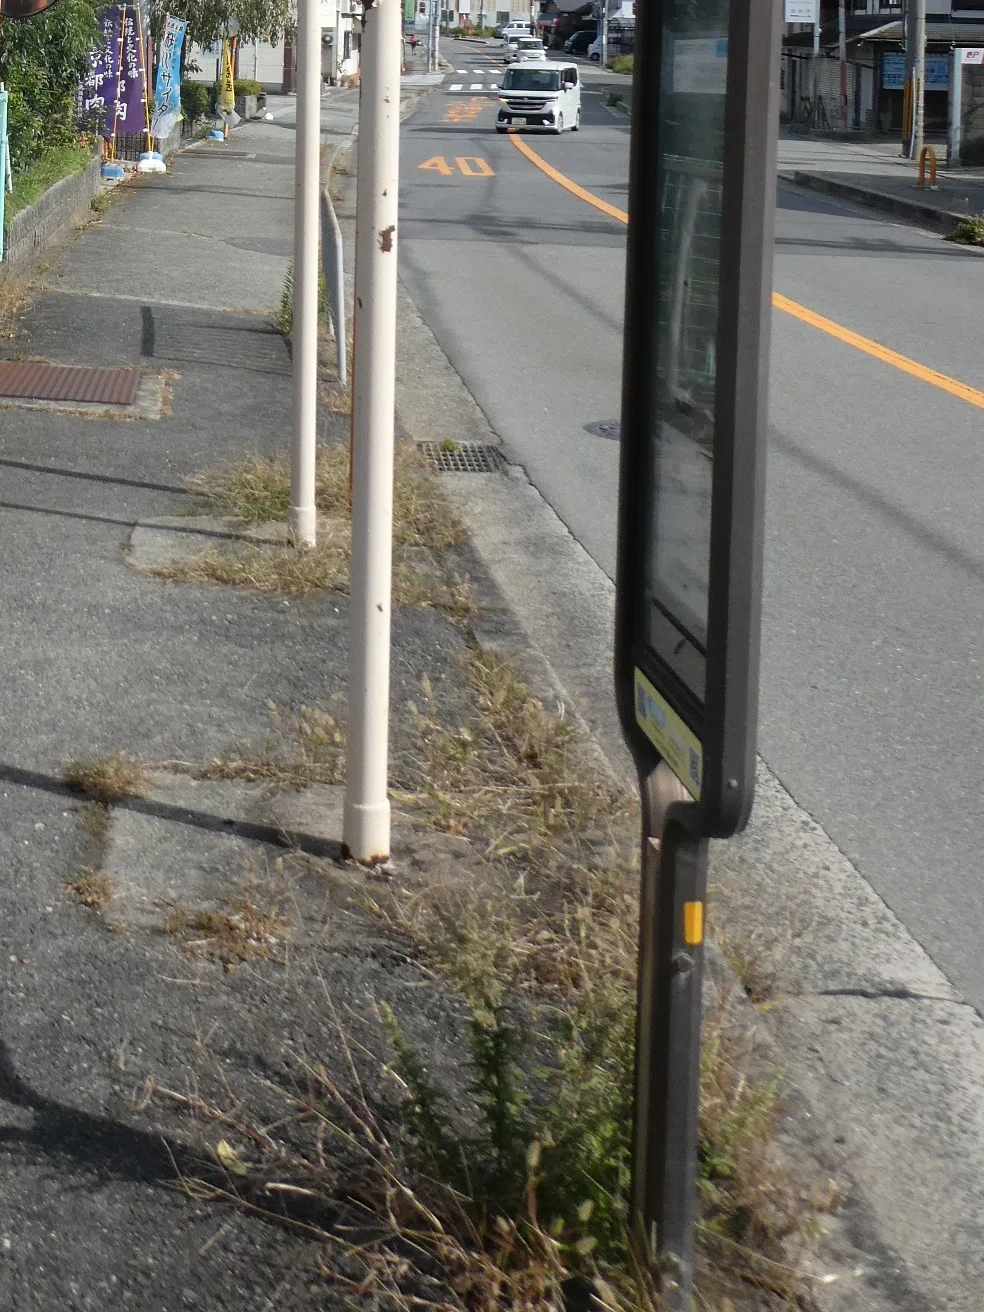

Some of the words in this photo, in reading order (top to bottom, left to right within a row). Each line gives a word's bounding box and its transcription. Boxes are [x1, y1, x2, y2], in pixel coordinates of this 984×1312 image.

[125, 17, 139, 79] 伝統と文化の味
[418, 155, 496, 176] 40
